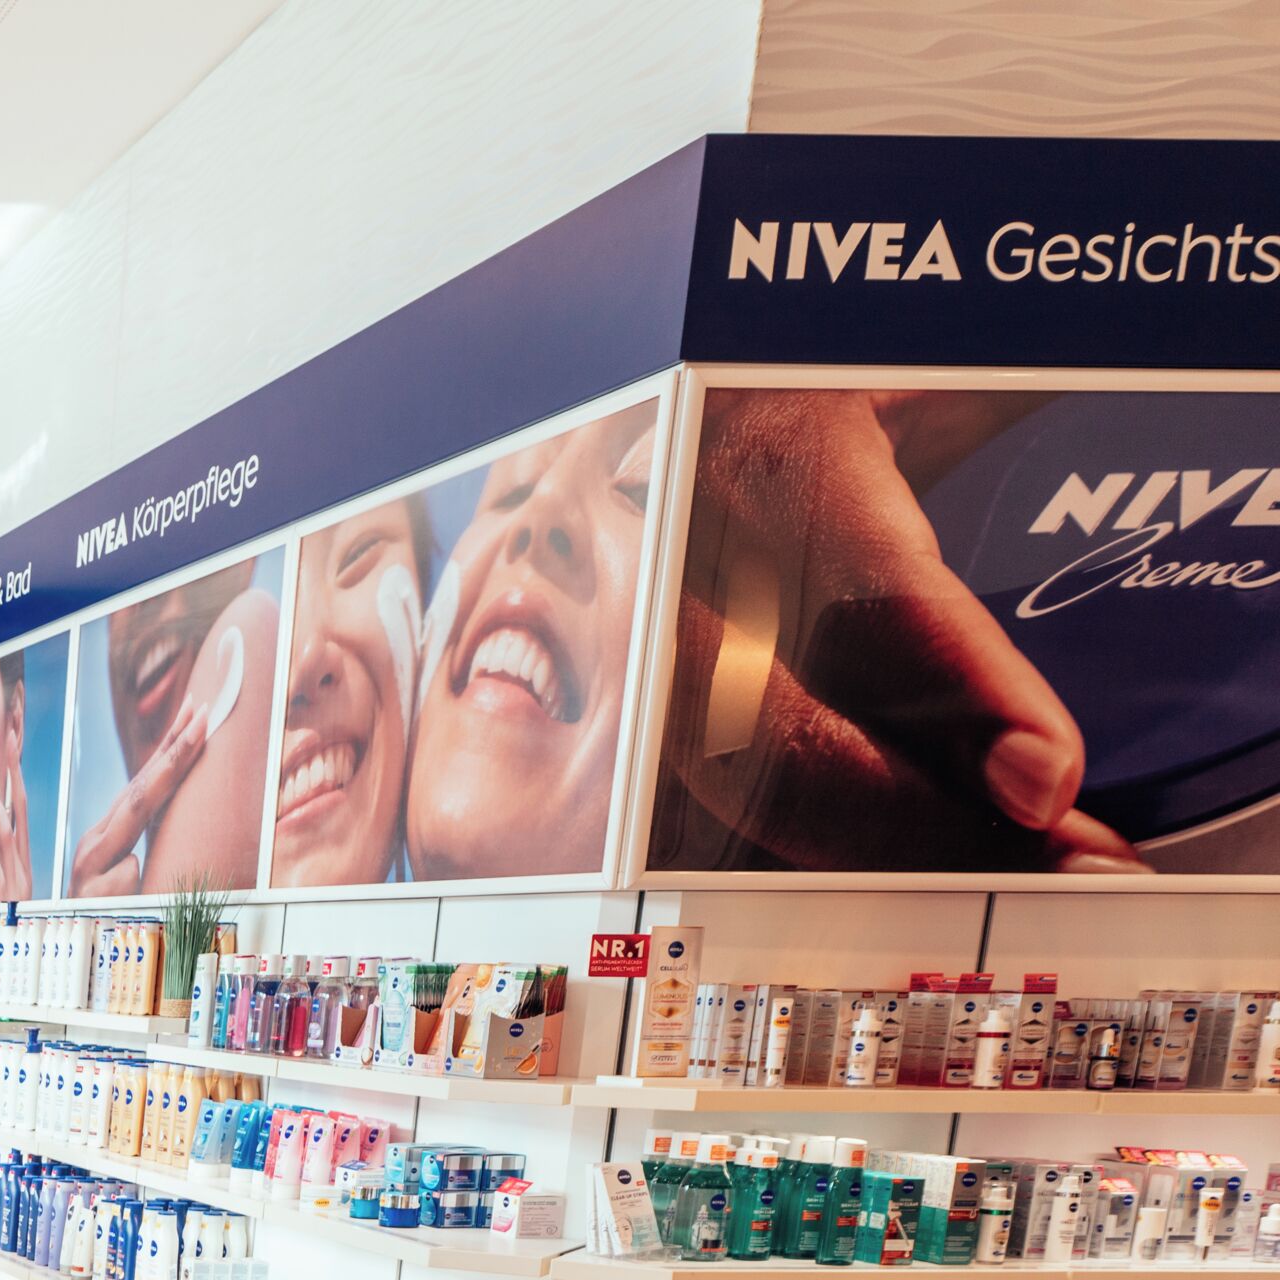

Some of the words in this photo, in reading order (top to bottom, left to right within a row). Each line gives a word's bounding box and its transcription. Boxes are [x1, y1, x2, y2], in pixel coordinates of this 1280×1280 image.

[728, 217, 961, 283] NIVEA
[986, 220, 1280, 283] Gesichts
[76, 512, 128, 568] NIVEA
[132, 454, 260, 541] Körperpflege
[6, 562, 32, 603] Bad
[592, 939, 645, 958] NR.1
